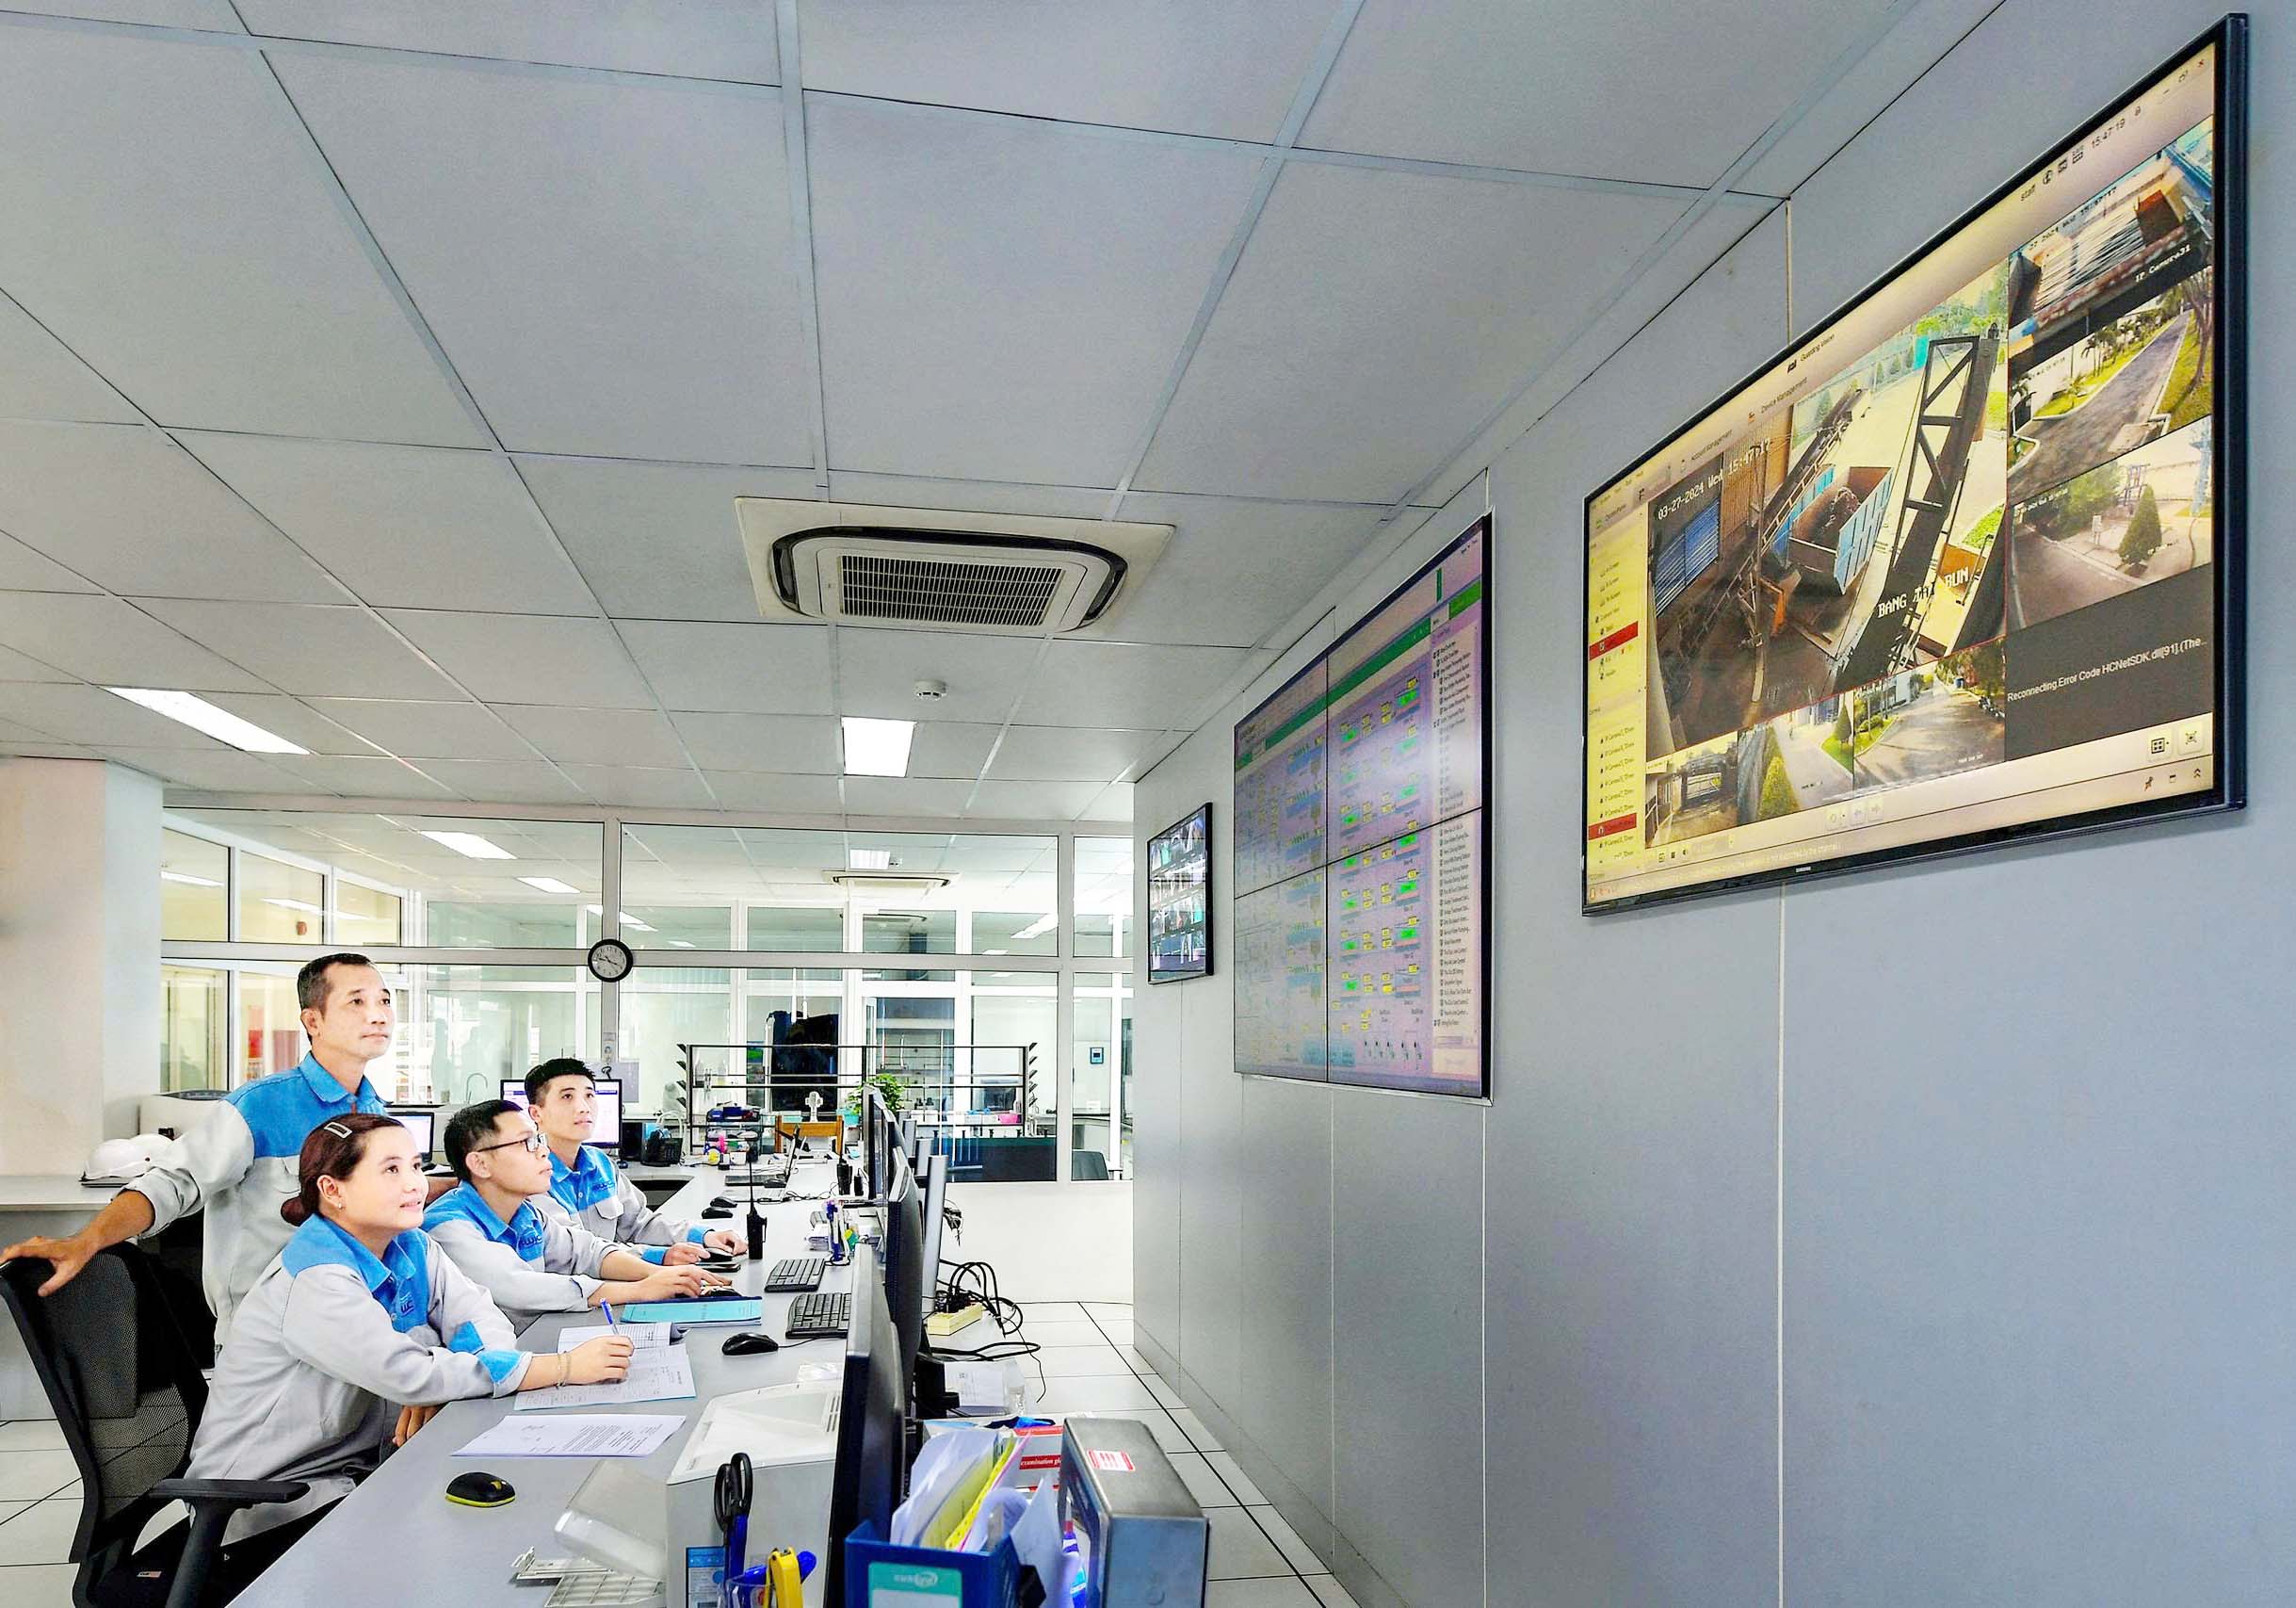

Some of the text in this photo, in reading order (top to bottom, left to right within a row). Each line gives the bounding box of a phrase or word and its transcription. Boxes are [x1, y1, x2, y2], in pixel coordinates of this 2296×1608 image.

[1657, 482, 1705, 520] 03-27-2024
[1707, 469, 1724, 489] Wed
[1877, 593, 1907, 618] BANG
[2078, 668, 2101, 681] Code
